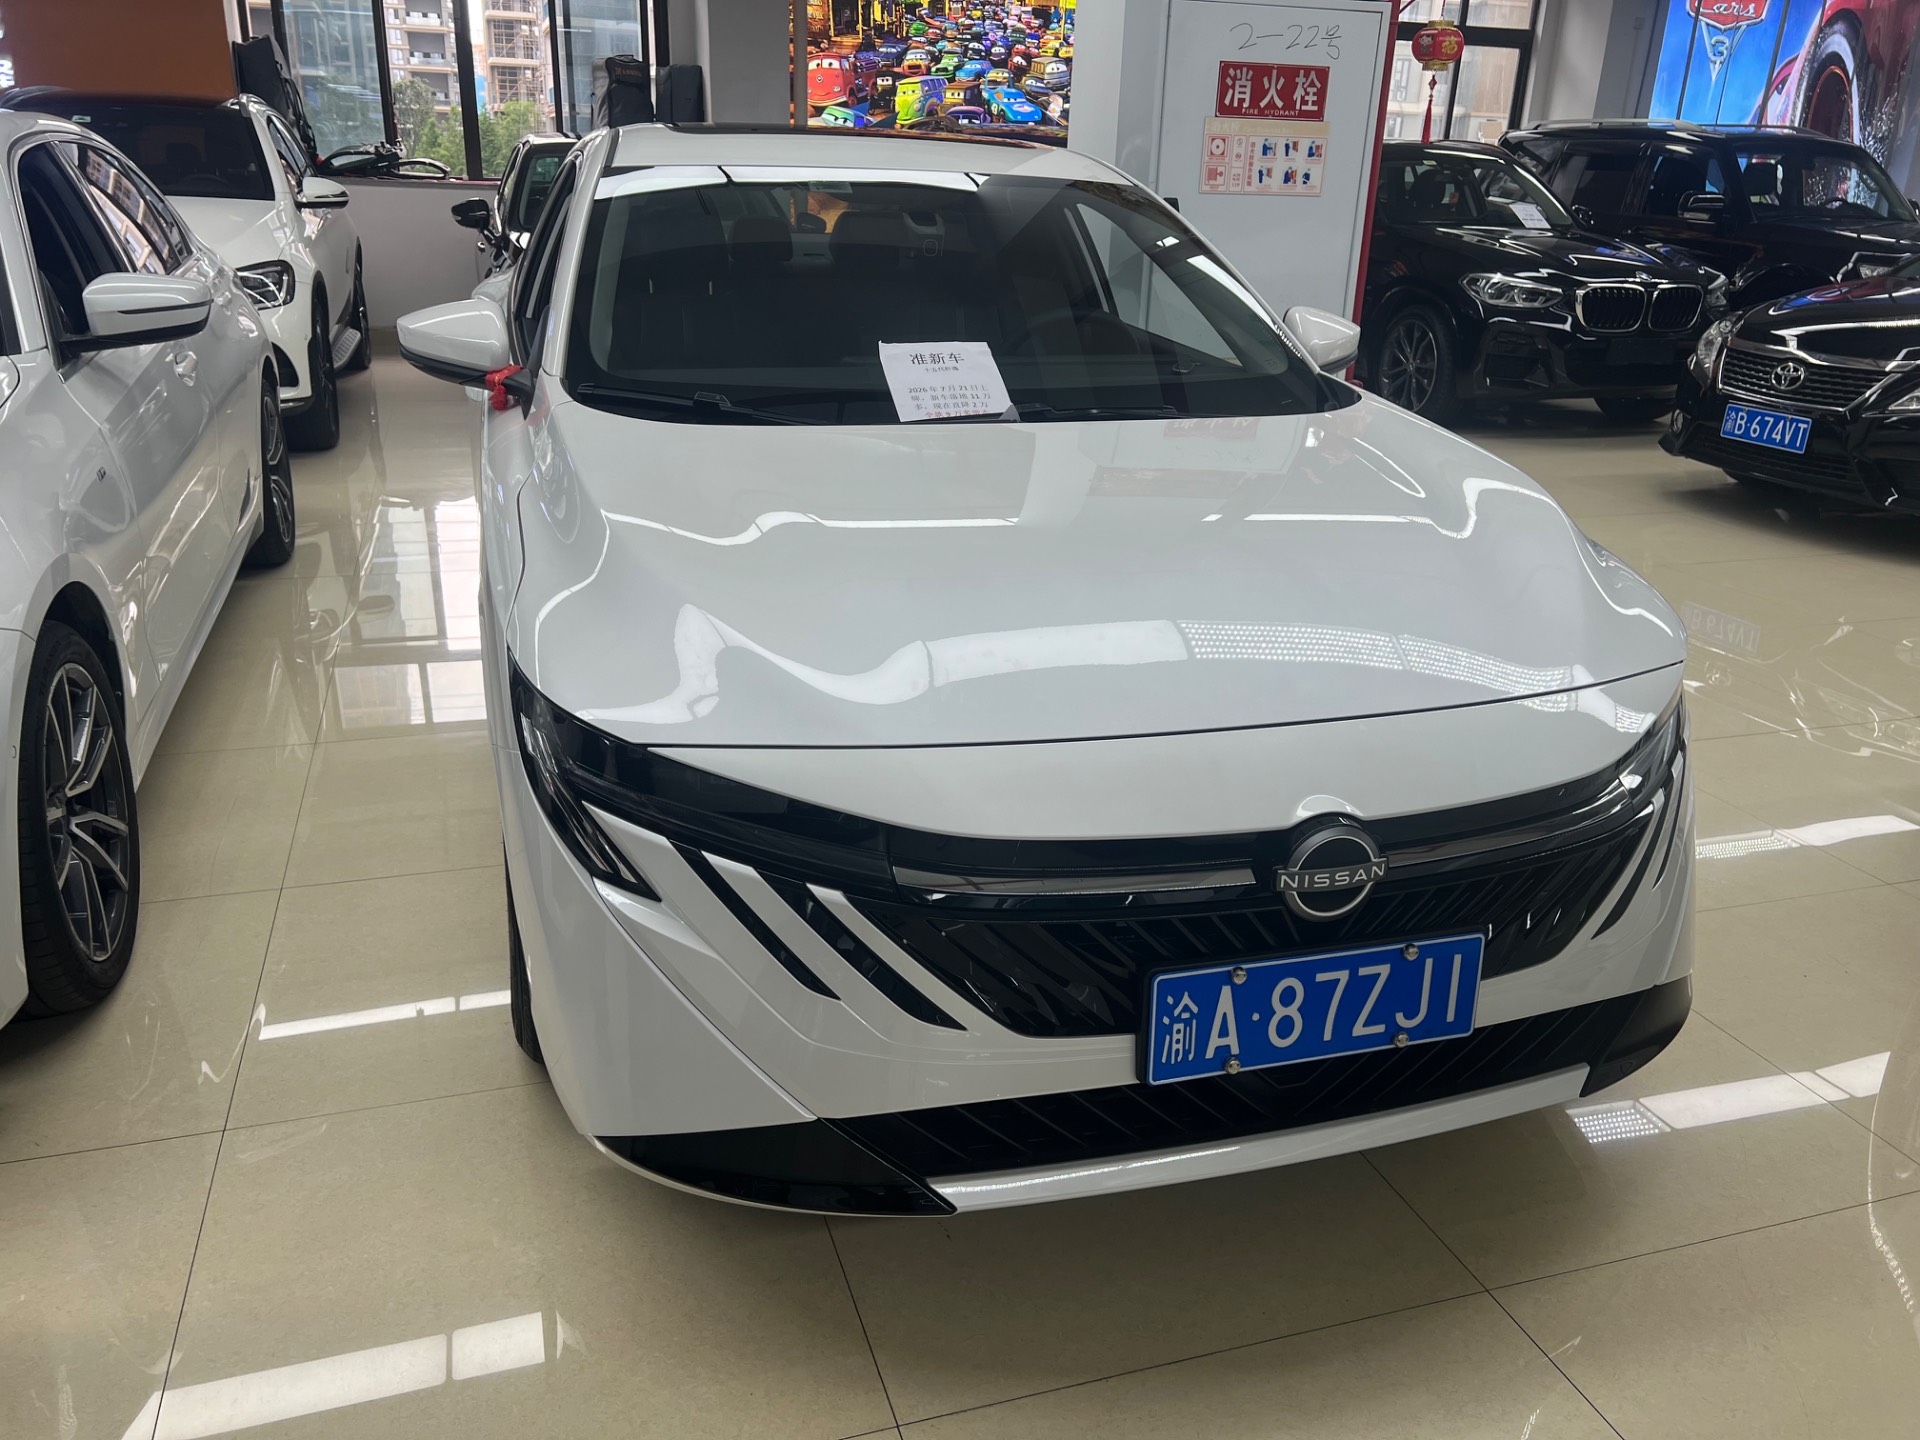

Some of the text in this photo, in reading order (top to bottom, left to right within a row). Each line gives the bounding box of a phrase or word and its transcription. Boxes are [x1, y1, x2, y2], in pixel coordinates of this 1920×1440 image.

[1223, 66, 1321, 111] 消火栓
[1264, 109, 1300, 117] HYDRANT
[909, 352, 964, 365] 准新车
[1280, 864, 1386, 889] NISSAN
[1161, 953, 1462, 1065] 渝A·87ZJ1
